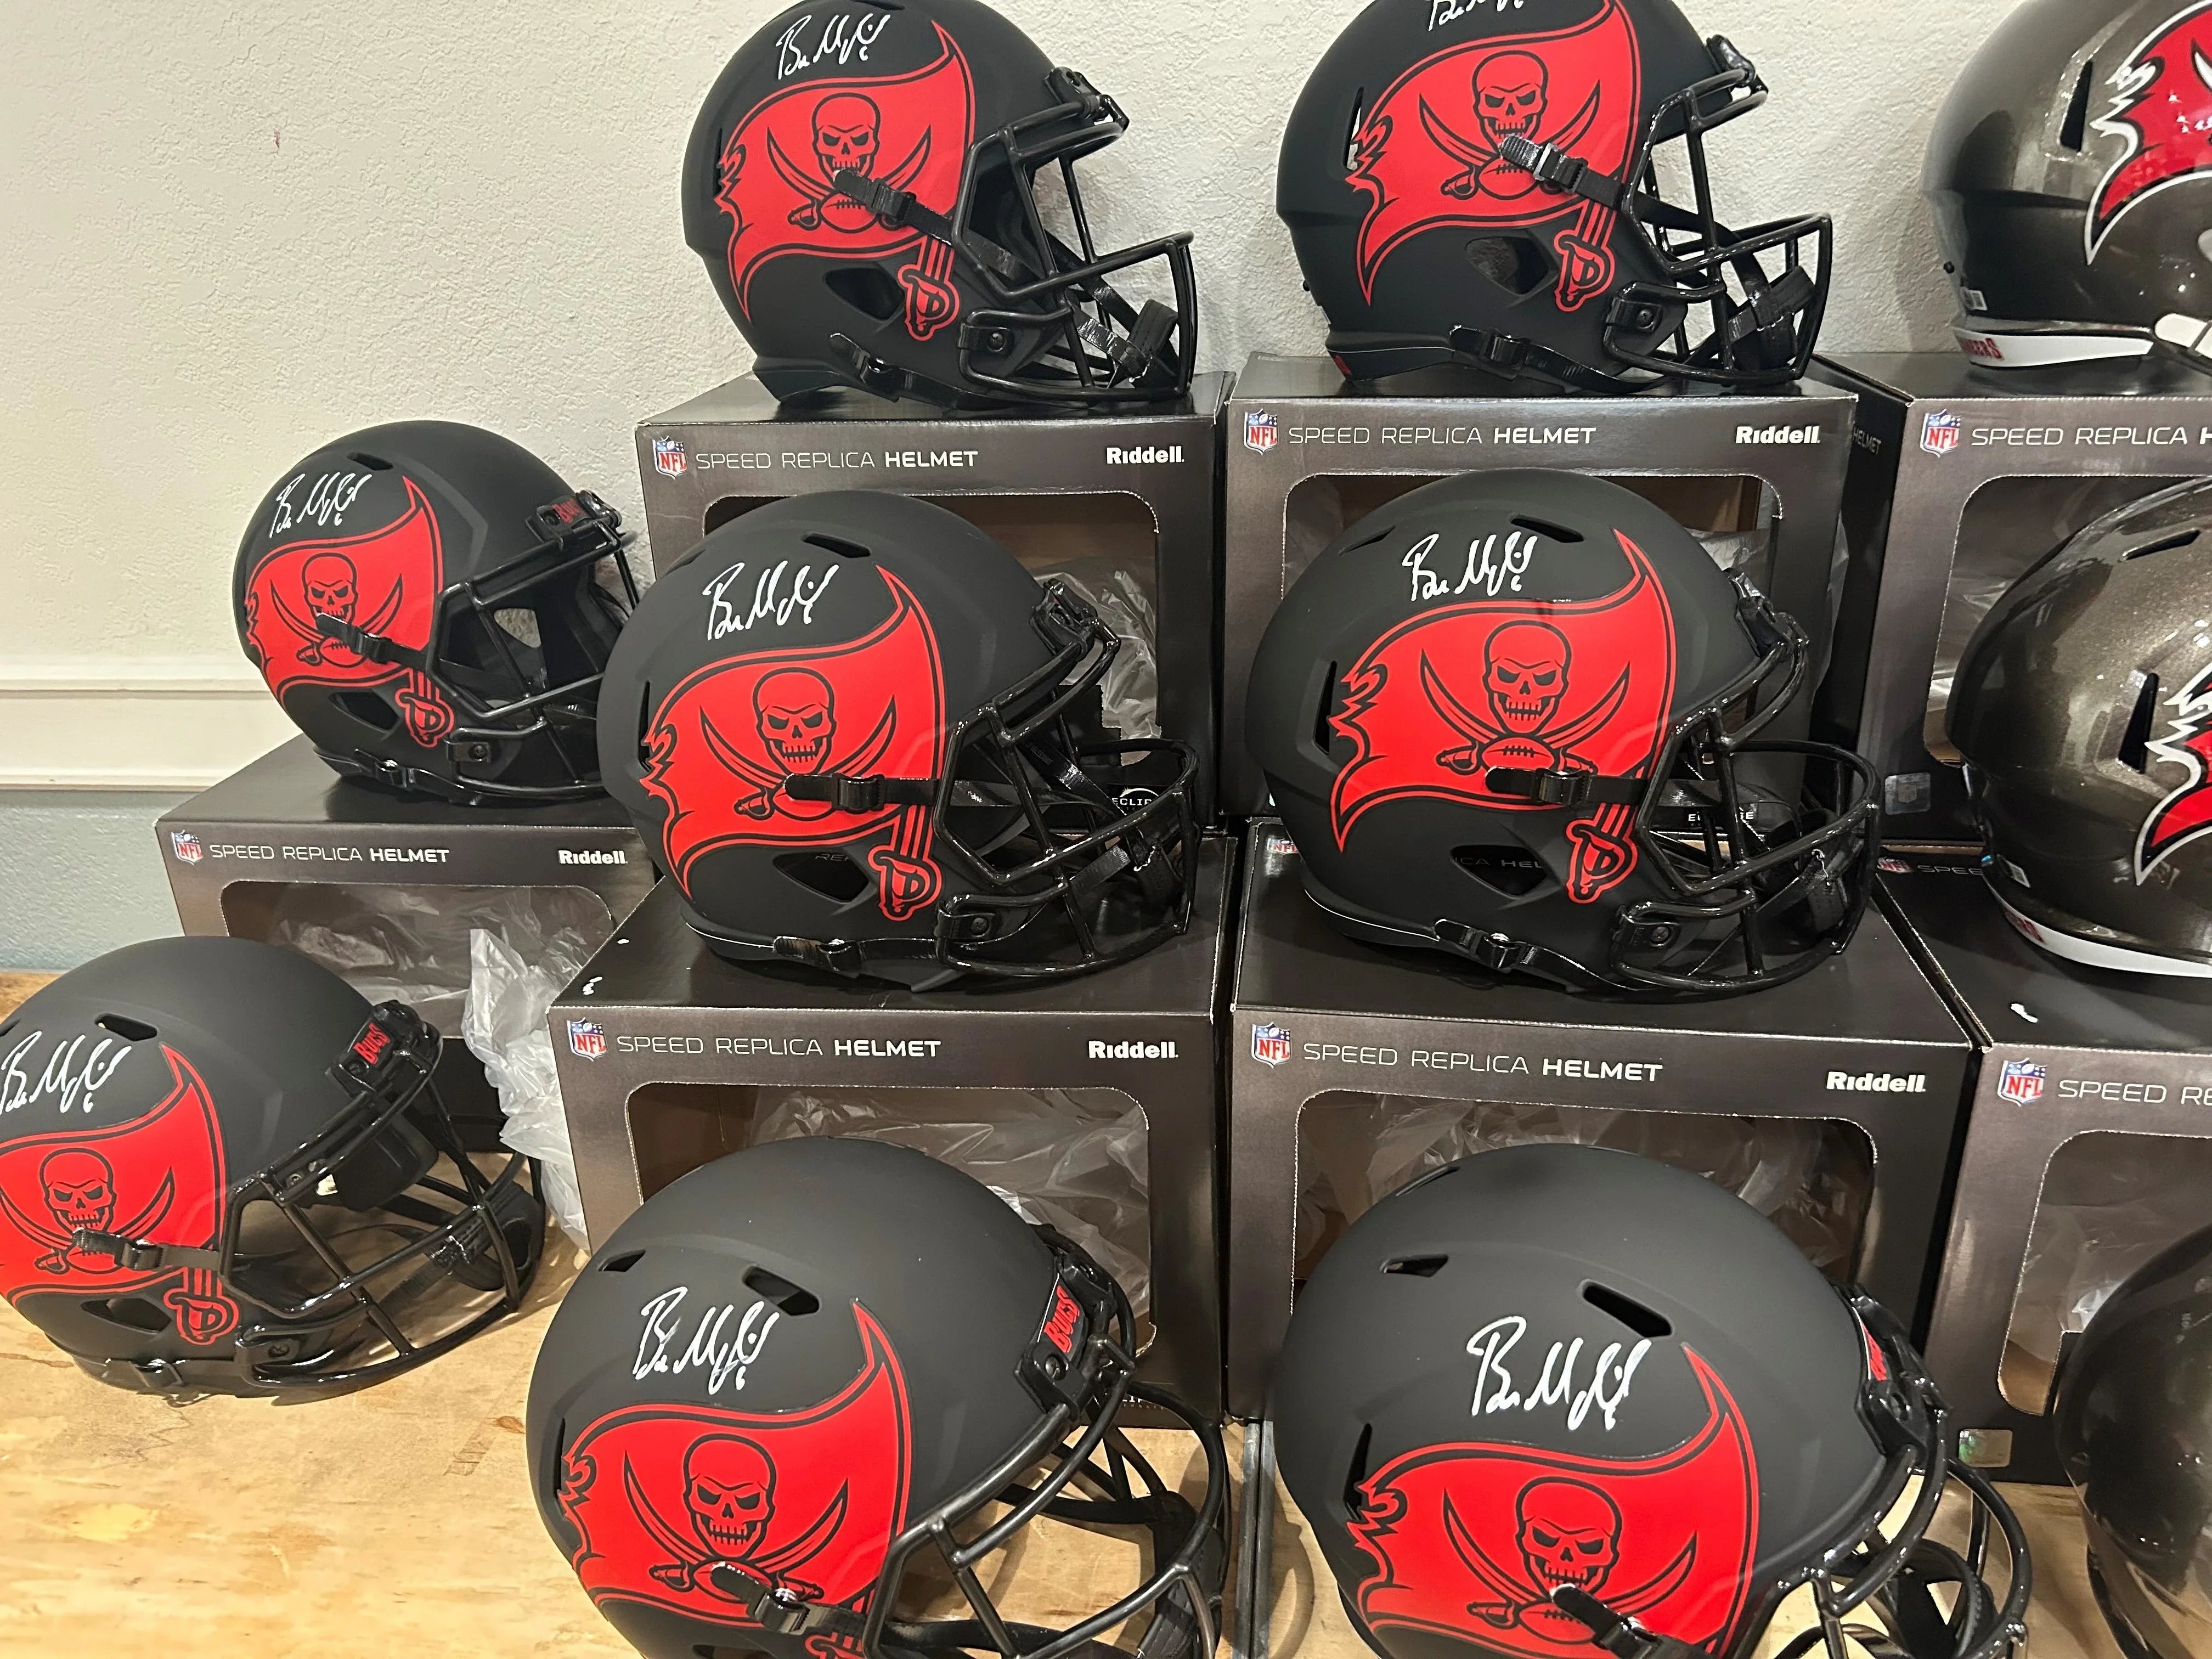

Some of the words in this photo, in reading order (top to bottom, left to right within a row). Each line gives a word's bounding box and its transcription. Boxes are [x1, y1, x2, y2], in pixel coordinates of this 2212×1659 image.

[1289, 427, 1370, 444] SPEED
[1381, 427, 1482, 444] REPLICA
[1493, 427, 1597, 444] HELMET
[1971, 428, 2063, 445] SPEED
[2075, 427, 2187, 445] REPLICA
[696, 453, 771, 469] SPEED
[782, 452, 875, 469] REPLICA
[885, 450, 978, 467] HELMET
[1111, 798, 1152, 806] ECLIP
[210, 845, 275, 860] SPEED
[283, 846, 363, 862] REPLICA
[370, 848, 449, 863] HELMET
[1501, 860, 1543, 868] HEL
[1917, 865, 1982, 876] SPEE
[616, 1036, 704, 1054] SPEED
[715, 1037, 823, 1056] REPLICA
[834, 1039, 941, 1057] HELMET
[1303, 1043, 1398, 1066] SPEED
[1410, 1049, 1530, 1075] REPLICA
[1542, 1058, 1663, 1082] HELMET
[2058, 1080, 2167, 1104] SPEED
